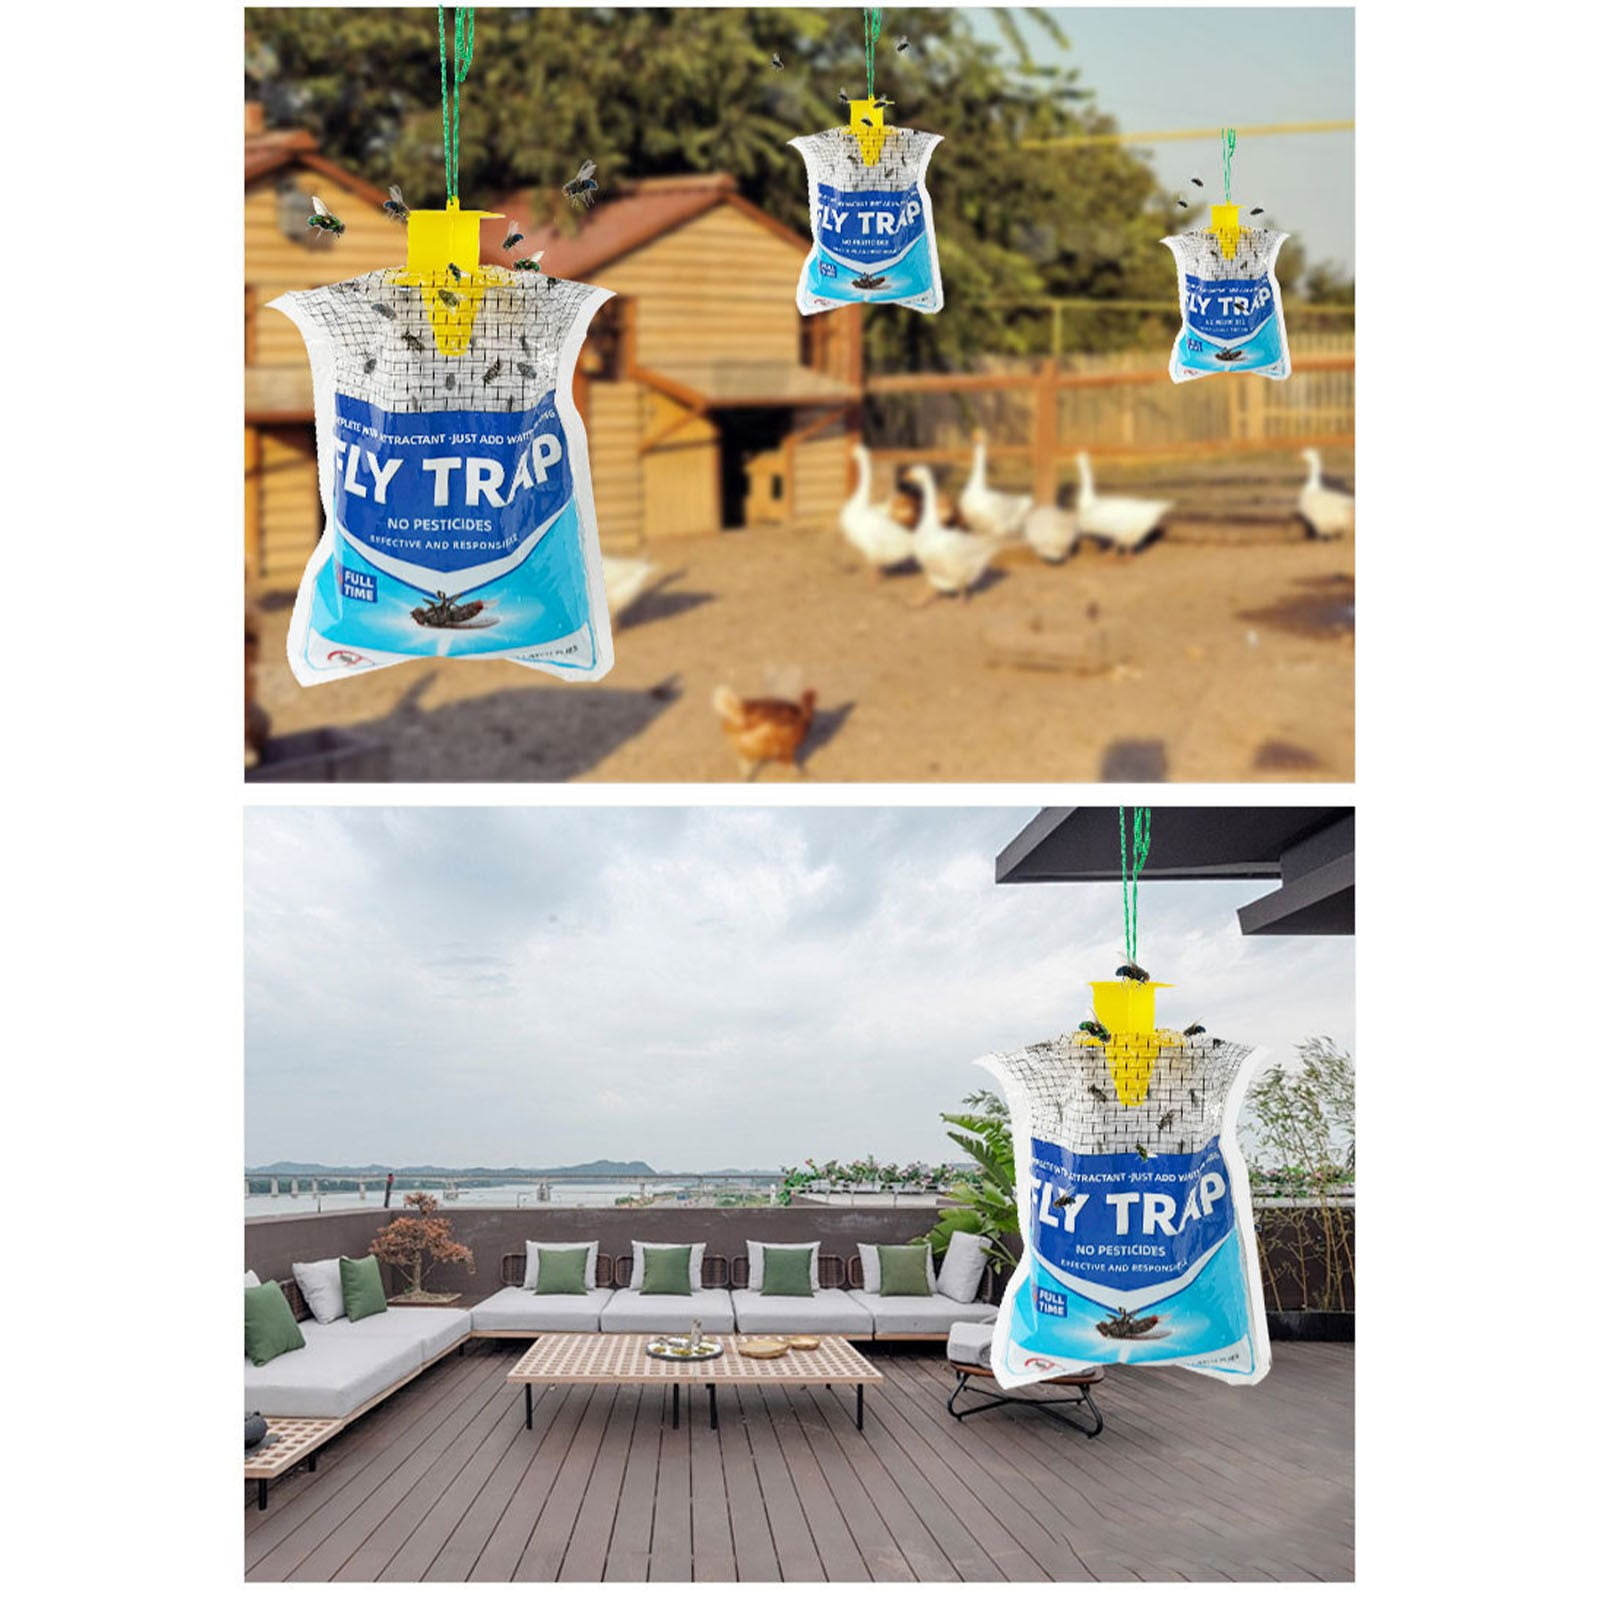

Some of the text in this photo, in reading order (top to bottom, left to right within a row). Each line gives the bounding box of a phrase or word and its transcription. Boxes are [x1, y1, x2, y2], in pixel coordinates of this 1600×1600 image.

[857, 200, 921, 235] TRAP
[1217, 286, 1271, 316] TRAP
[480, 434, 504, 445] ADD
[422, 433, 562, 508] TRAP
[387, 517, 492, 532] NO PESTICIDES
[369, 534, 422, 549] EFFECTIVE
[425, 540, 449, 550] AND
[345, 570, 375, 588] FULL
[344, 584, 374, 602] TIME
[1155, 1173, 1176, 1182] ADD
[1106, 1172, 1226, 1236] TRAP
[1076, 1244, 1166, 1257] NO PESTICIDES
[1108, 1263, 1129, 1272] AND
[1039, 1288, 1065, 1305] FULL
[1039, 1301, 1064, 1316] TIME
